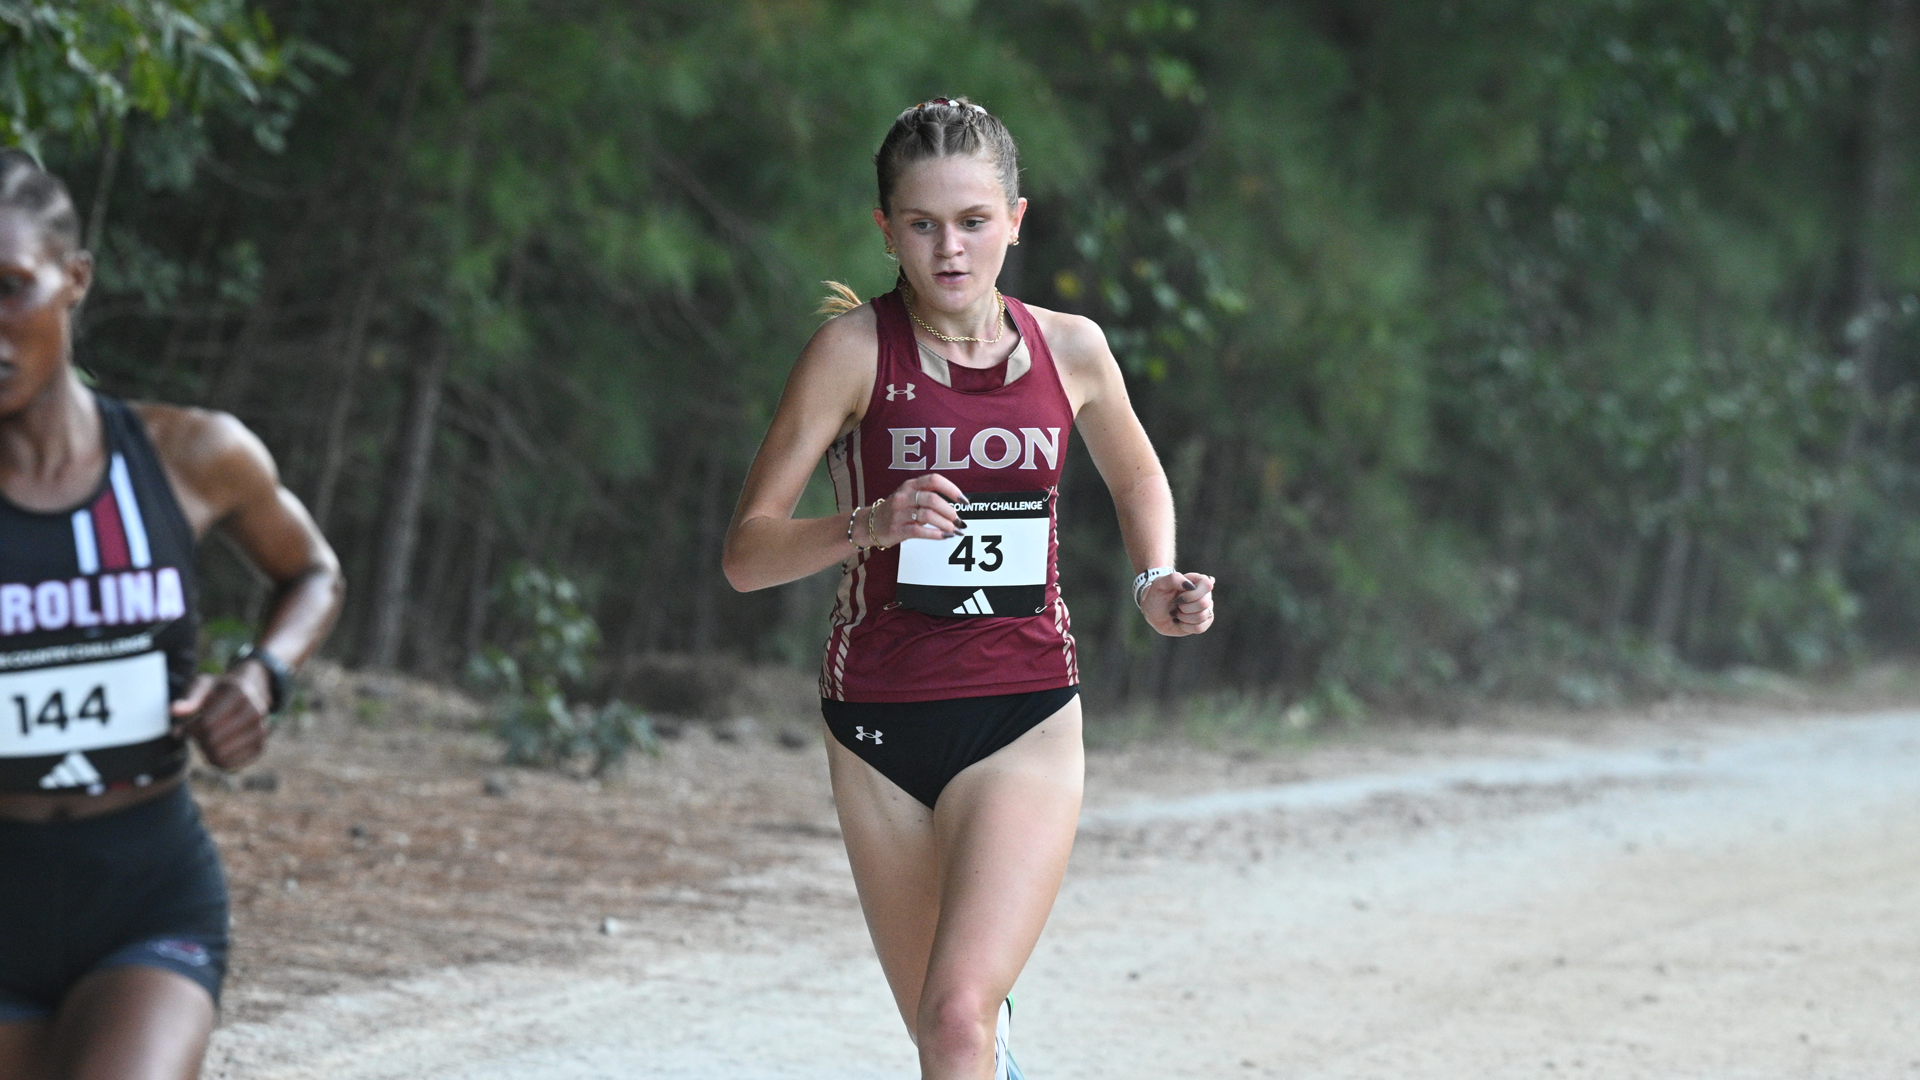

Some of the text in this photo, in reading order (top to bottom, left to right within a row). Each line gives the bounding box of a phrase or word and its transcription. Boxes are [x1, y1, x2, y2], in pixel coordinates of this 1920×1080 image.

[887, 427, 1061, 471] ELON
[990, 501, 1043, 511] CHALLENGE
[948, 535, 1004, 572] 43
[12, 684, 110, 736] 144
